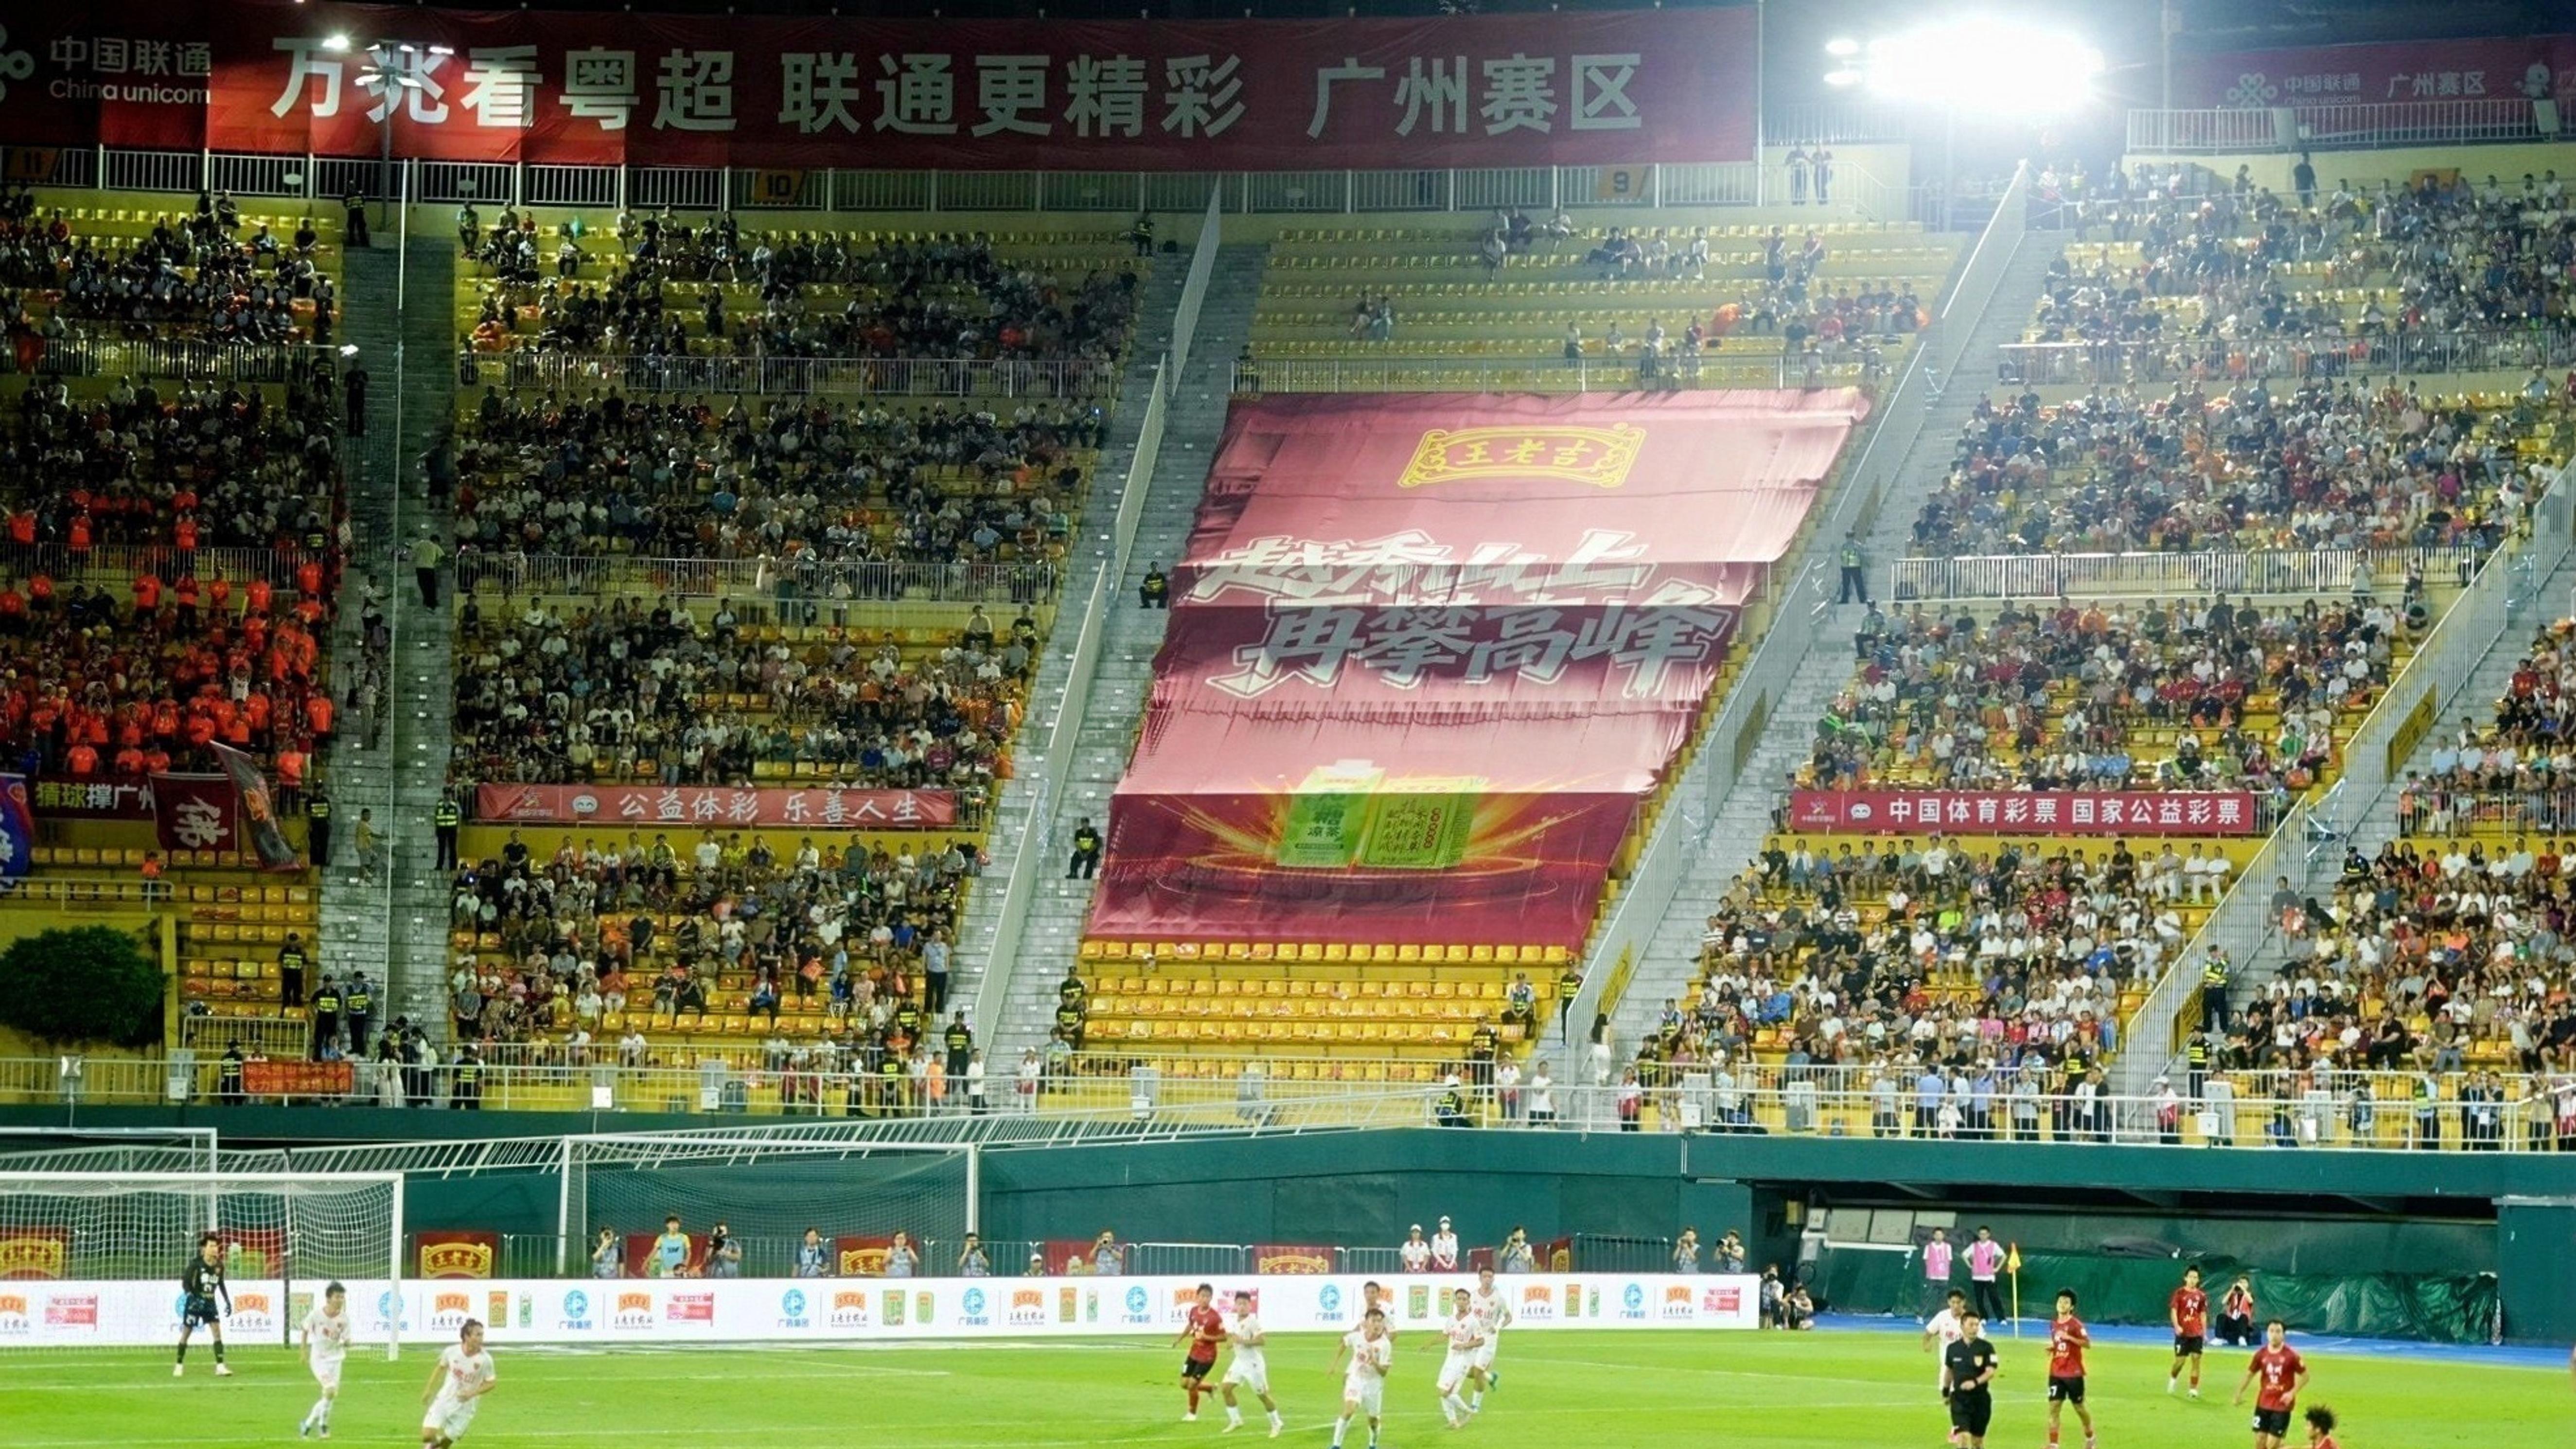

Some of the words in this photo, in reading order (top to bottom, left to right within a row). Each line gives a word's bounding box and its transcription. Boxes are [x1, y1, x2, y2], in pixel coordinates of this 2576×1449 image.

[50, 35, 211, 76] 中国联通
[50, 77, 118, 100] China
[123, 83, 210, 104] unicom
[270, 37, 737, 132] 万兆看粤超
[778, 51, 1246, 139] 联通更精彩
[1306, 53, 1642, 140] 广州赛区
[2284, 72, 2361, 92] 中国联通
[2387, 71, 2487, 98] 广州赛区
[766, 174, 792, 195] 10
[1612, 172, 1630, 193] 9
[1456, 437, 1592, 466] 王老吉
[1205, 578, 1735, 699] 再攀高峰
[619, 789, 759, 822] 公益体彩
[783, 790, 922, 823] 乐善人生
[1889, 797, 2058, 824] 中国体育彩票
[2071, 798, 2241, 825] 国家公益彩票
[436, 1251, 476, 1267] 王老吉
